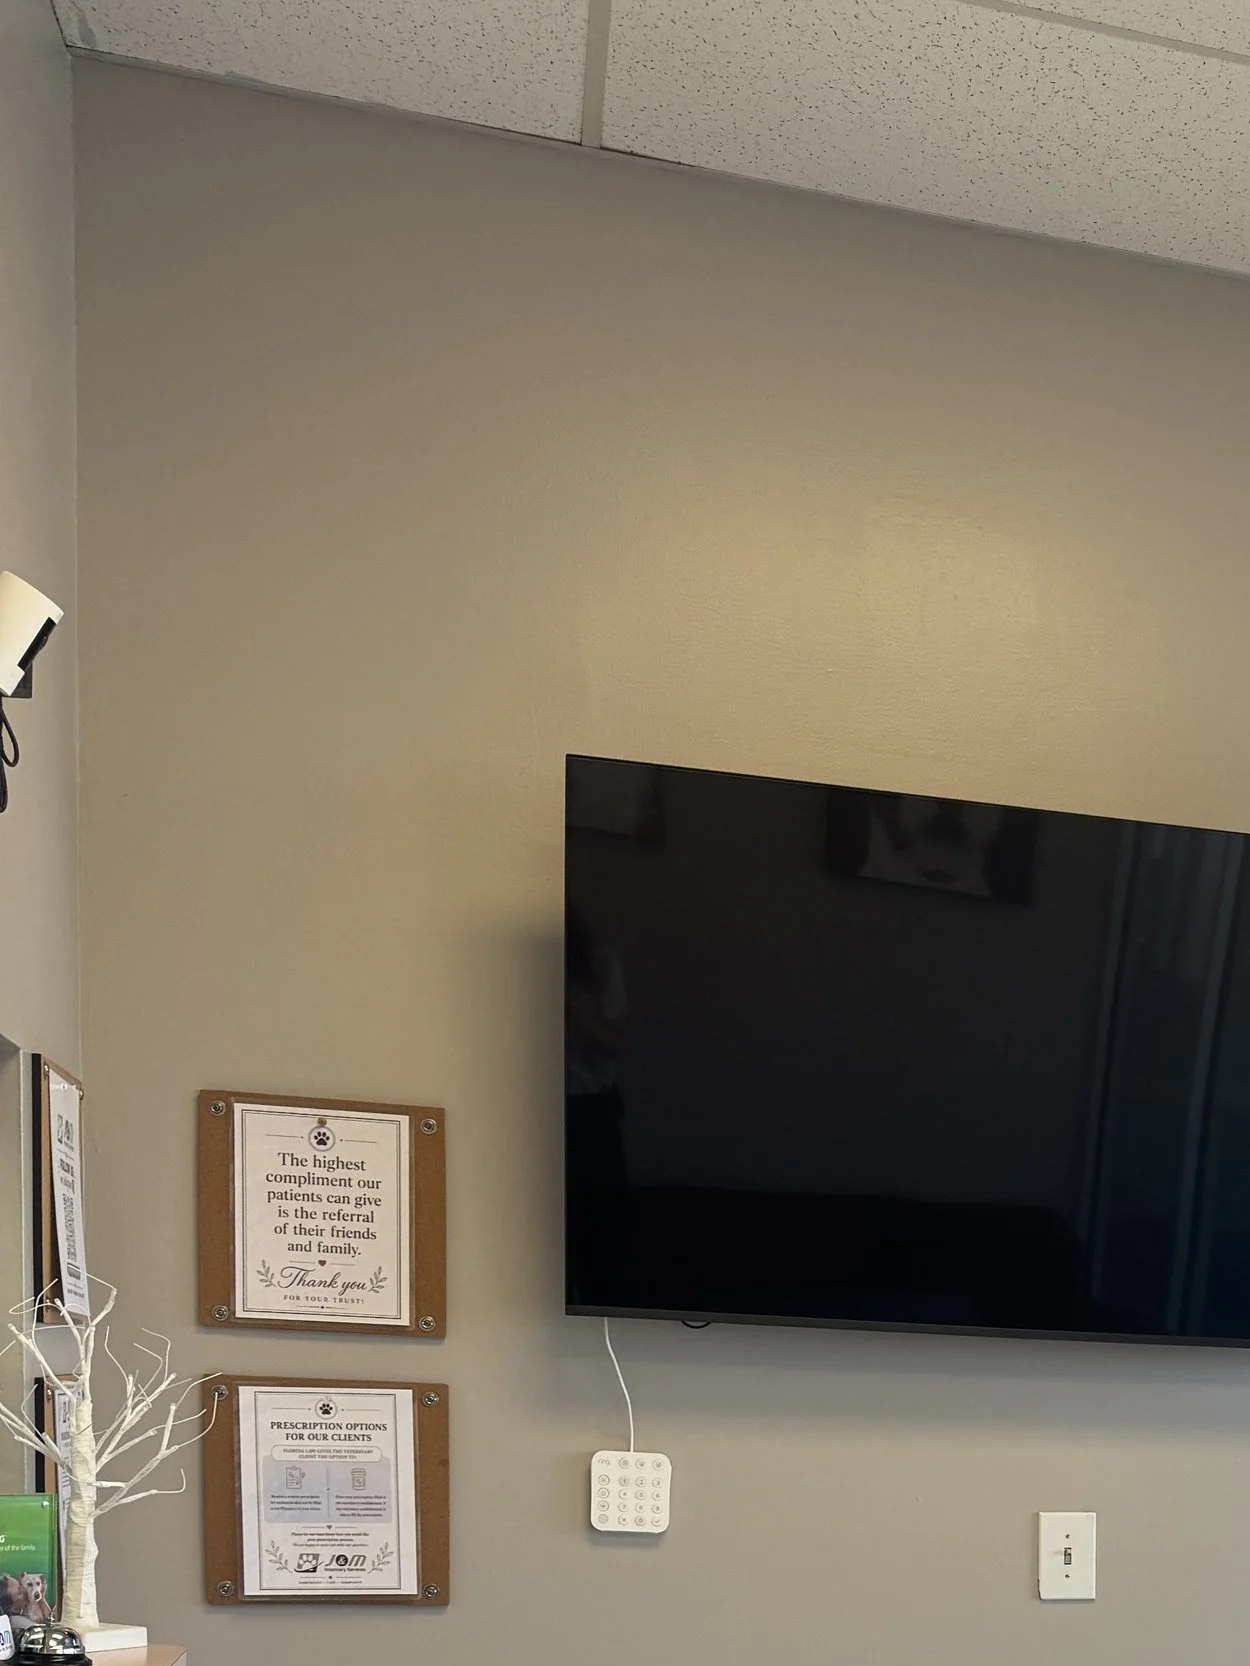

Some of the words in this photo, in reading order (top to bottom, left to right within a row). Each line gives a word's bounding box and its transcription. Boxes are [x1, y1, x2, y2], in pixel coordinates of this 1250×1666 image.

[277, 1152, 308, 1168] The
[313, 1155, 366, 1172] highest
[265, 1173, 353, 1188] compliment
[357, 1178, 382, 1190] our
[267, 1190, 323, 1203] patients
[326, 1194, 350, 1204] can
[354, 1194, 382, 1208] give
[277, 1206, 289, 1218] is
[294, 1207, 318, 1220] the
[322, 1209, 375, 1223] referral
[274, 1223, 289, 1235] of
[293, 1224, 326, 1237] their
[330, 1225, 377, 1240] friends
[287, 1240, 312, 1253] and
[317, 1241, 362, 1258] family.
[277, 1266, 341, 1289] Thank
[338, 1280, 367, 1295] you
[305, 1295, 329, 1303] YOUR
[270, 1421, 343, 1431] PRESCRIPTION
[345, 1422, 388, 1431] OPTIONS
[285, 1433, 305, 1441] FOR
[307, 1433, 329, 1441] OUR
[331, 1433, 372, 1442] CLIENTS
